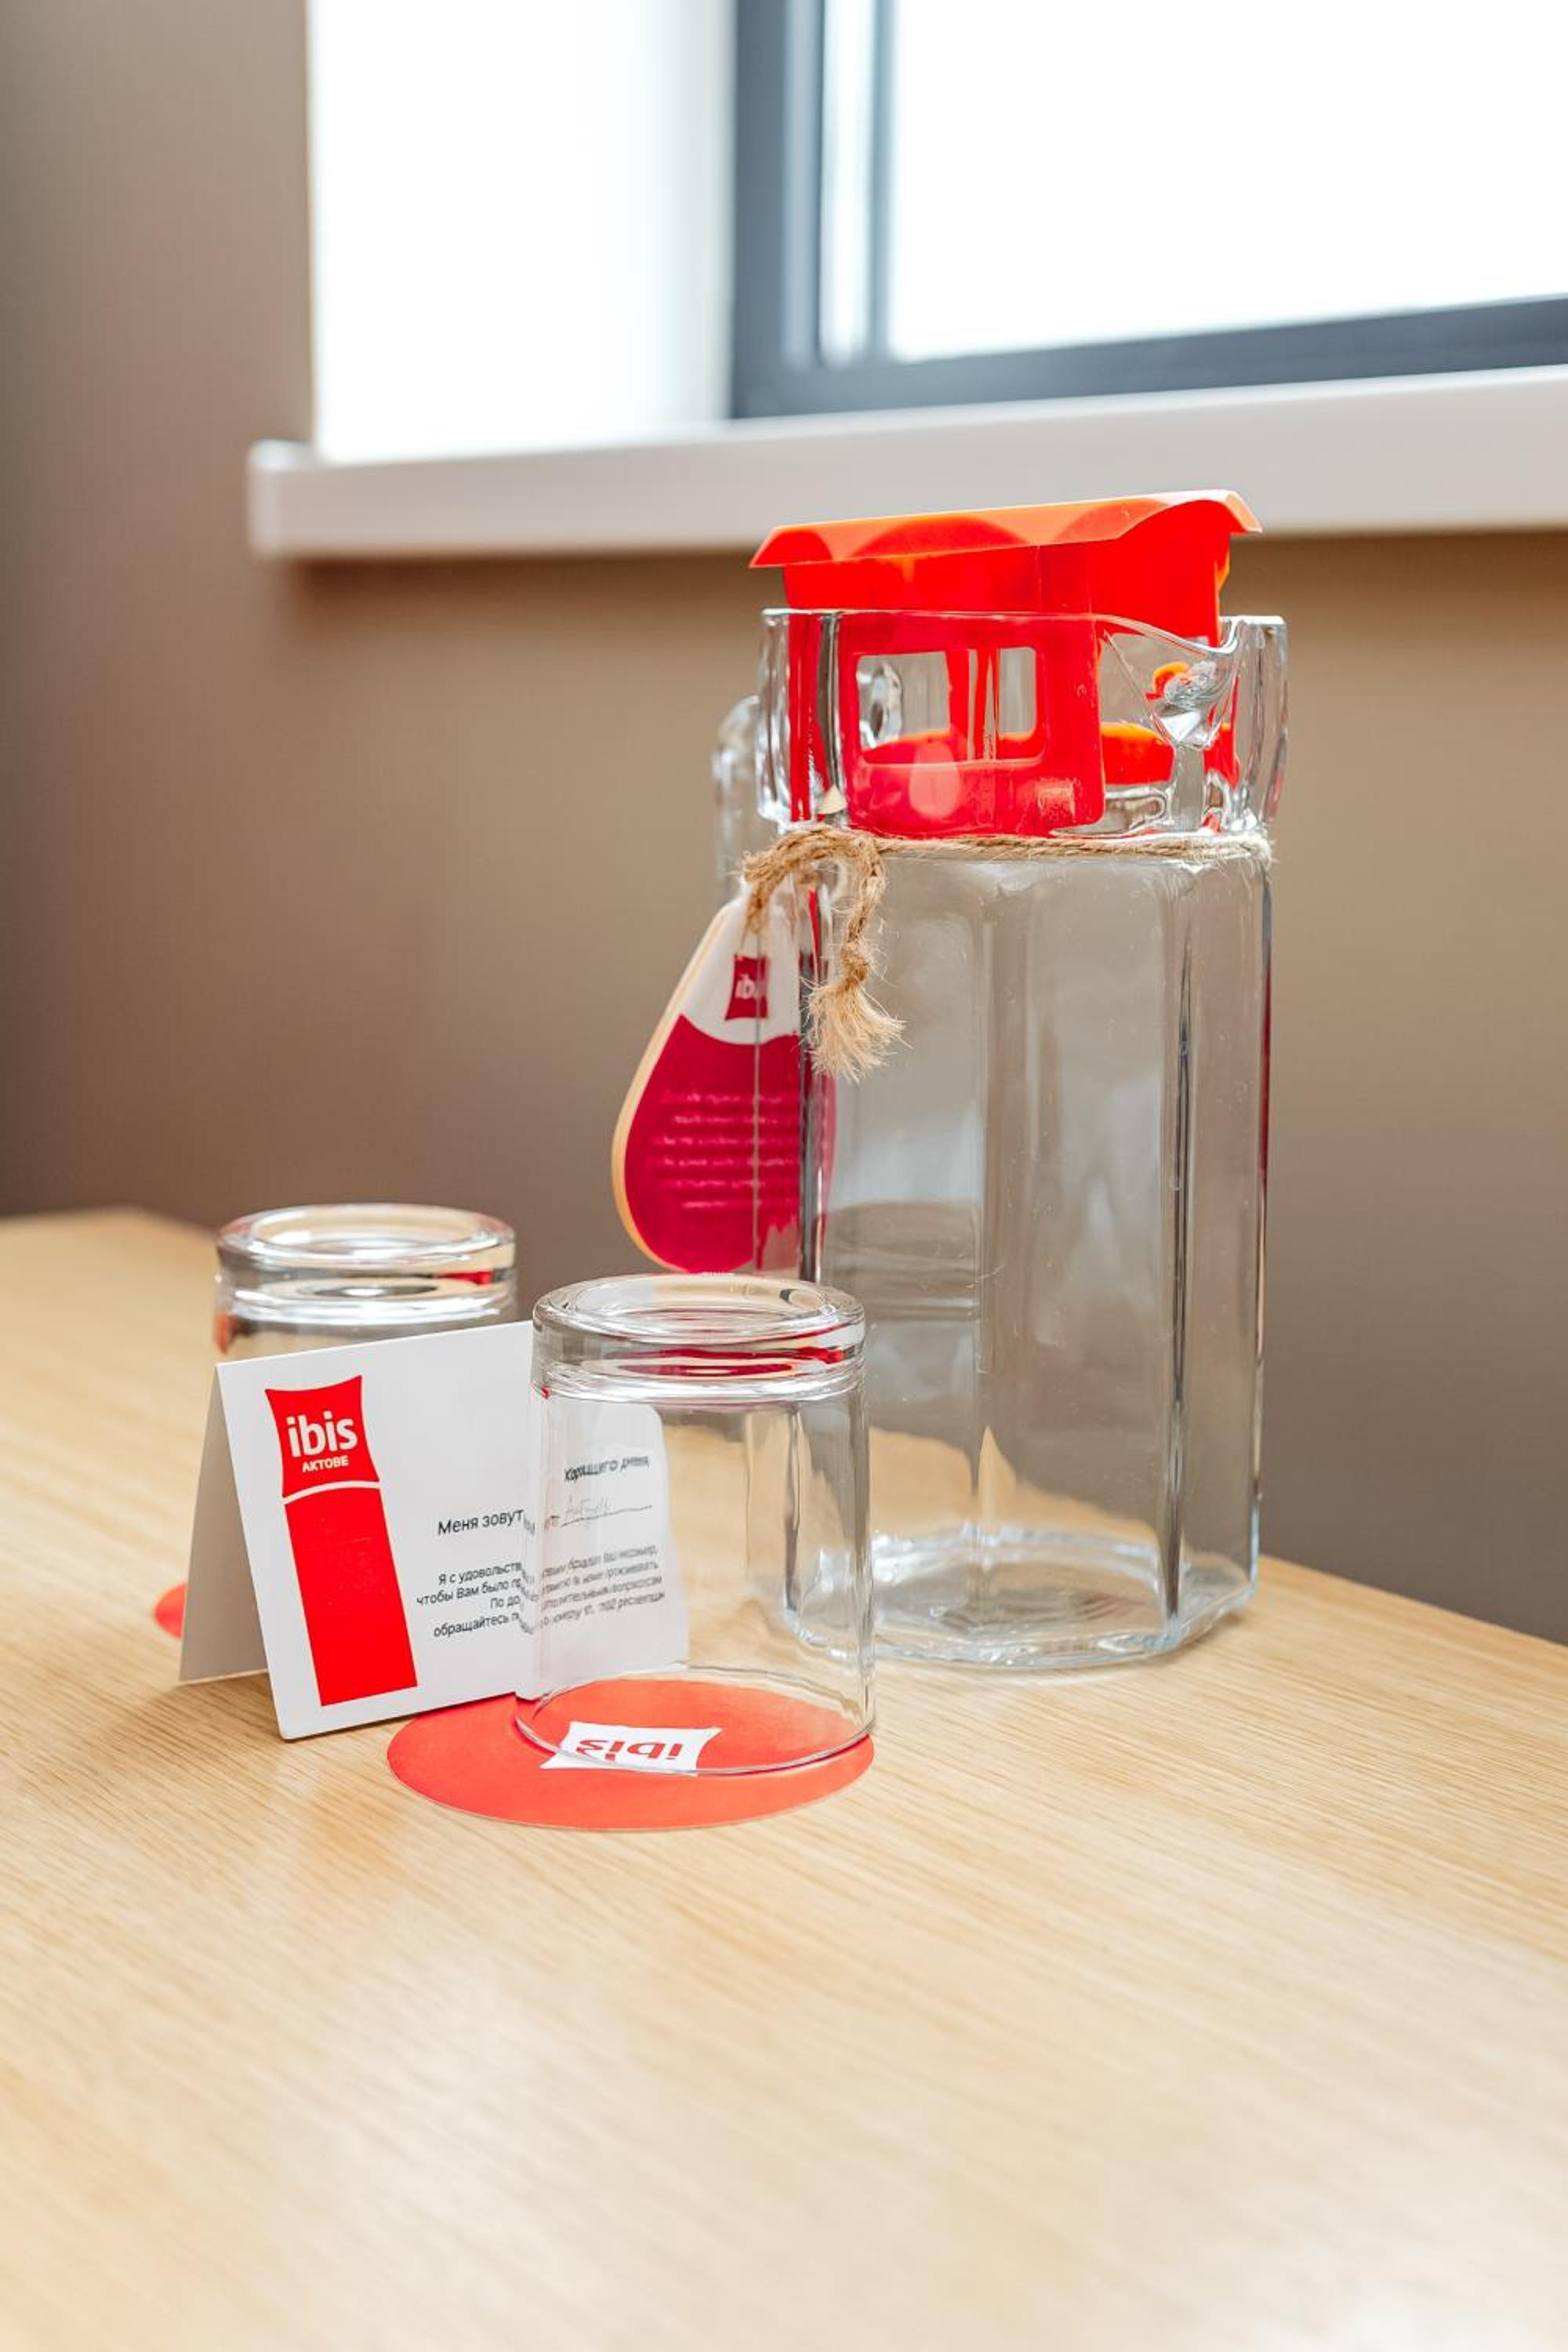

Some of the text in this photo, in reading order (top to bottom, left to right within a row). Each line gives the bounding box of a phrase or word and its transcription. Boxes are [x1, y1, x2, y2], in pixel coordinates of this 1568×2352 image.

[286, 1410, 358, 1457] ibis
[437, 1516, 479, 1536] Меня
[482, 1509, 524, 1527] зовут
[438, 1573, 446, 1585] Я
[449, 1573, 456, 1583] с
[416, 1589, 454, 1606] чтобы
[456, 1585, 479, 1599] Вам
[481, 1581, 509, 1594] было
[490, 1597, 504, 1609] По
[434, 1613, 510, 1638] обращайтесь
[576, 1740, 684, 1762] ibis
